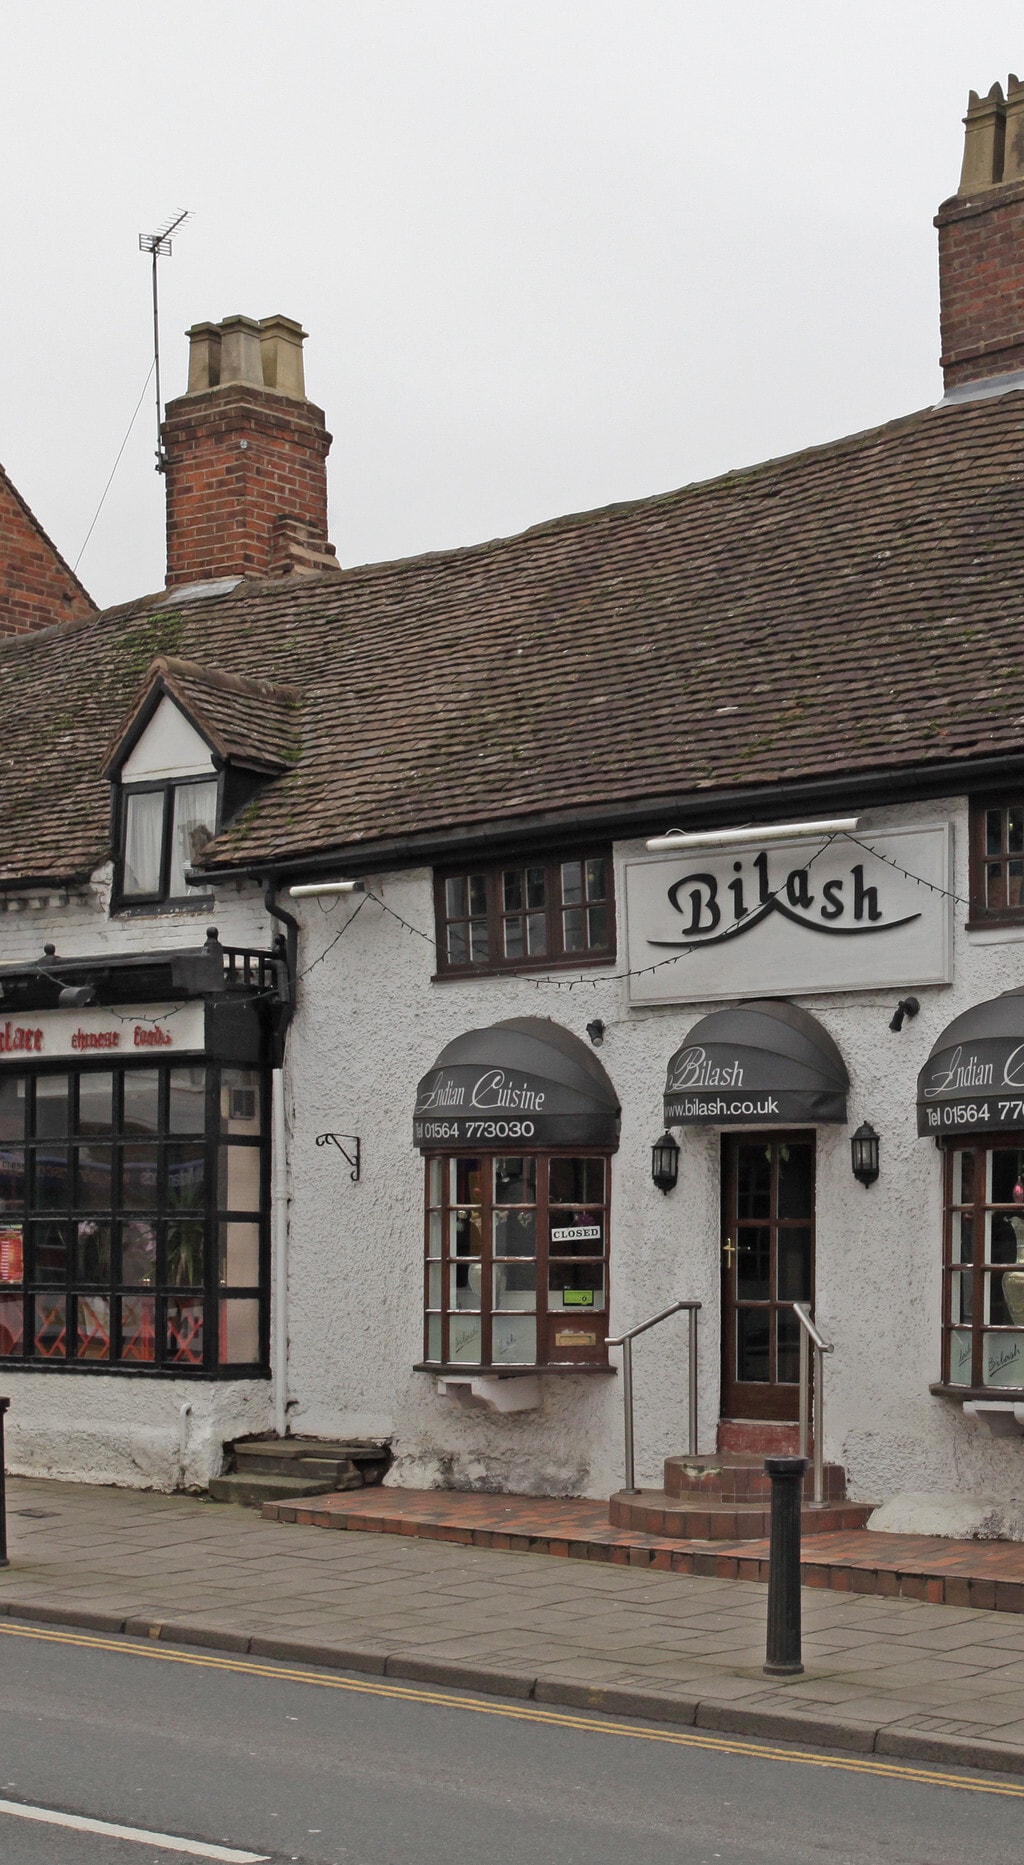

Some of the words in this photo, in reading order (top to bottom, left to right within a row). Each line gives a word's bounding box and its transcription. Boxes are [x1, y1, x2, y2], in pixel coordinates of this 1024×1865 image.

[667, 852, 882, 935] Bilash
[416, 1071, 465, 1114] Indian
[469, 1069, 545, 1111] Cuisine
[667, 1046, 744, 1092] Bilash
[924, 1046, 994, 1097] Indian
[424, 1122, 460, 1138] 01564
[465, 1121, 535, 1138] 773030
[926, 1108, 941, 1126] Tel
[943, 1103, 991, 1125] 01564
[553, 1228, 599, 1239] CLOSED
